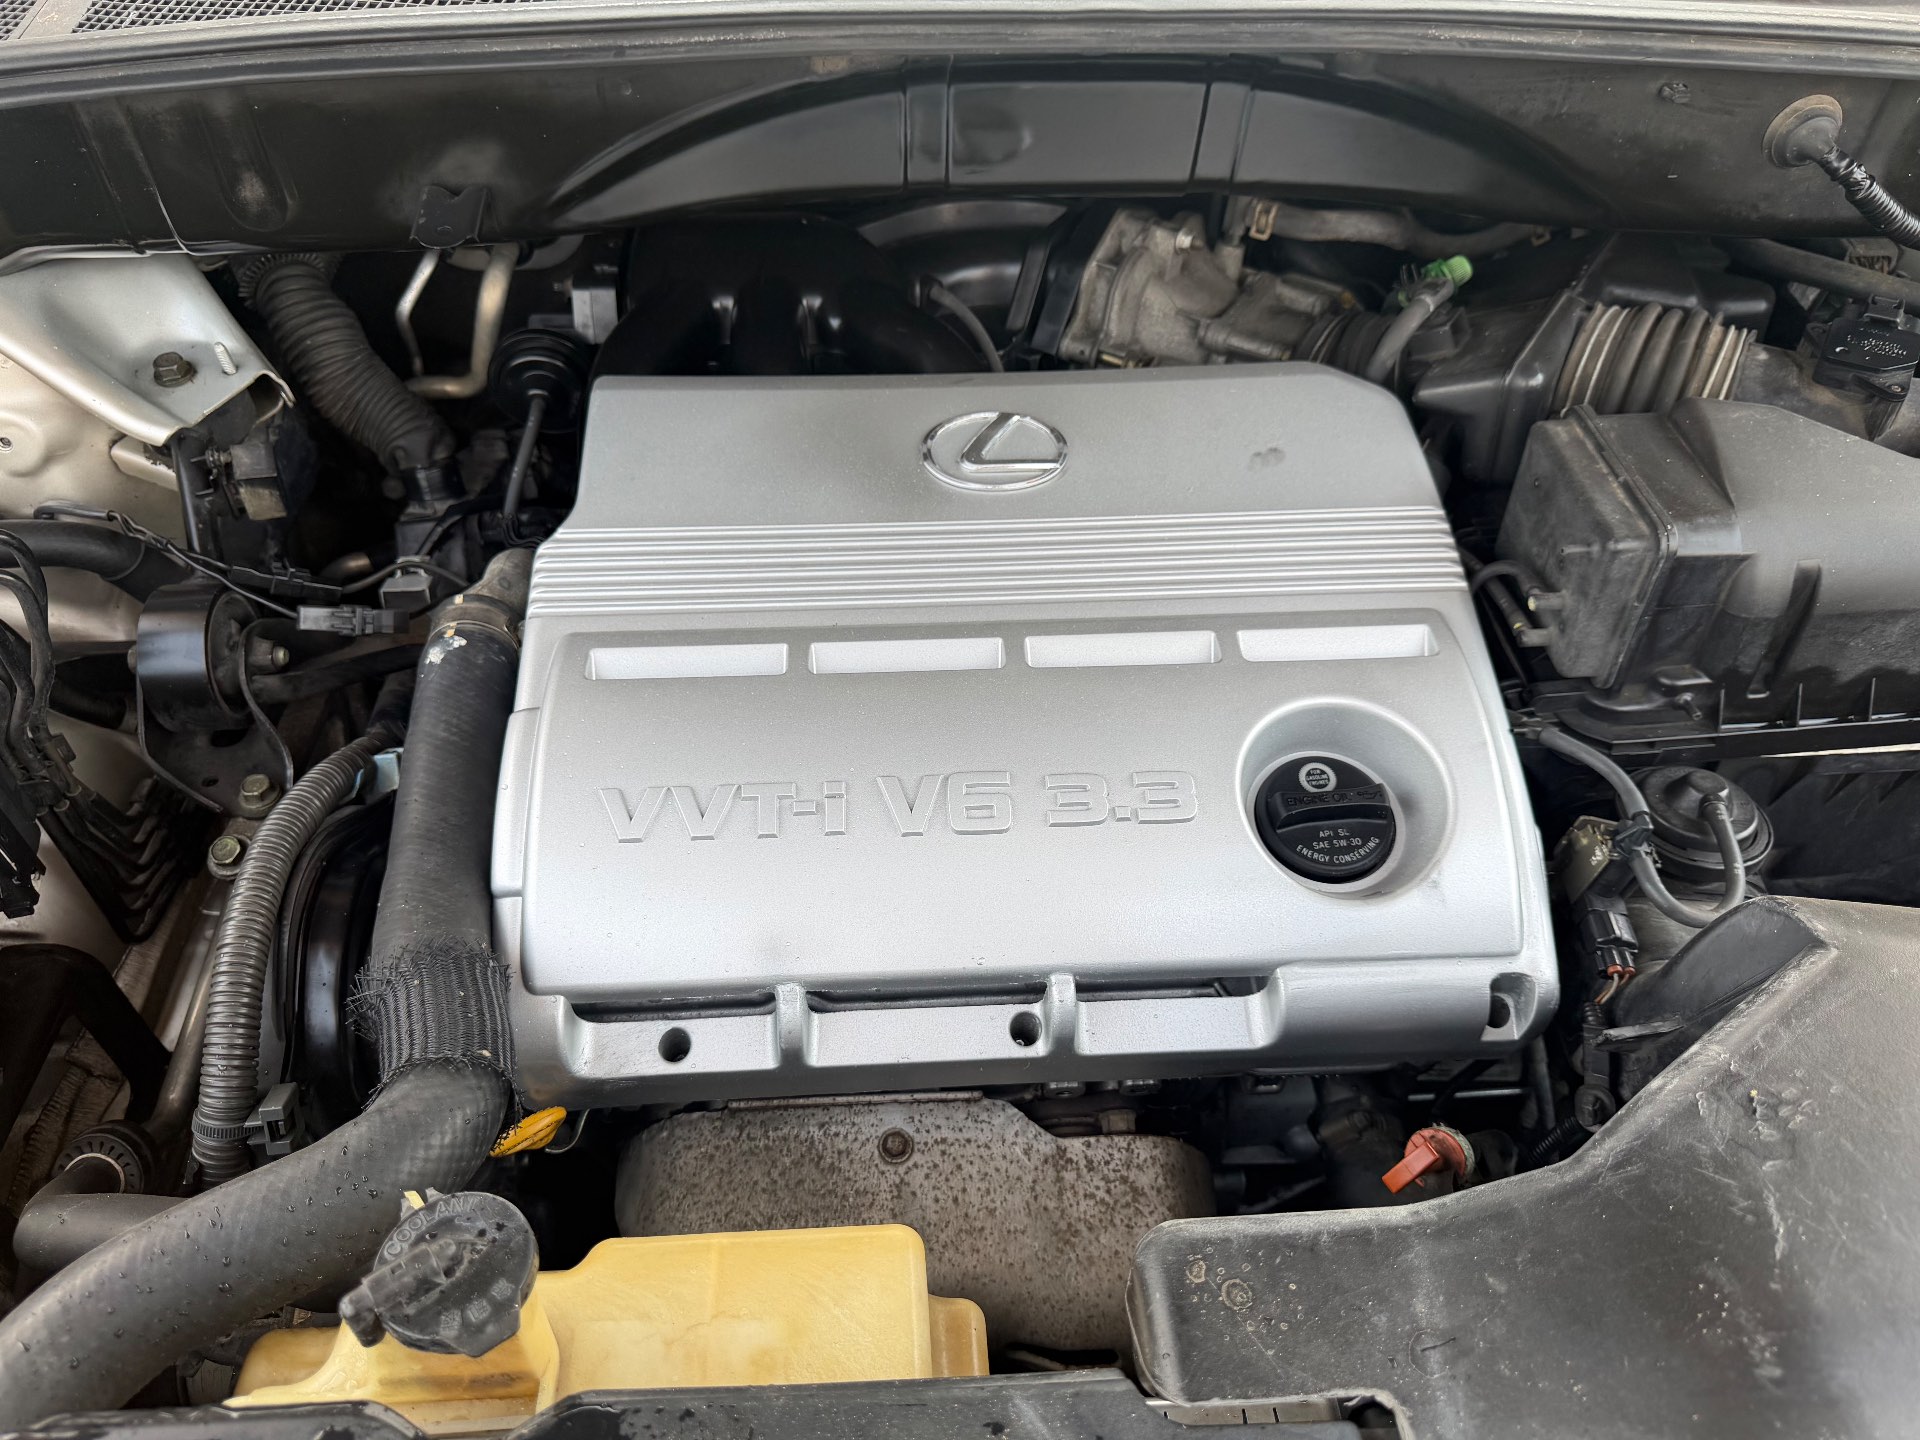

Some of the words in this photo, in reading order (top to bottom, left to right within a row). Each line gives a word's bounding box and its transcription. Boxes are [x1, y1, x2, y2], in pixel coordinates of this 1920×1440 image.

[599, 780, 847, 844] VVT-i
[876, 770, 1013, 838] V6
[1044, 769, 1199, 828] 3.3
[1287, 793, 1330, 806] ENGINE
[1331, 791, 1350, 804] OIL
[1312, 841, 1331, 850] SAE
[1333, 837, 1362, 848] 5W-30
[1319, 830, 1334, 838] API
[1337, 828, 1350, 836] SL
[1296, 844, 1330, 863] ENERGY
[1333, 836, 1380, 864] CONSERVING
[384, 1195, 482, 1262] COOLANT
